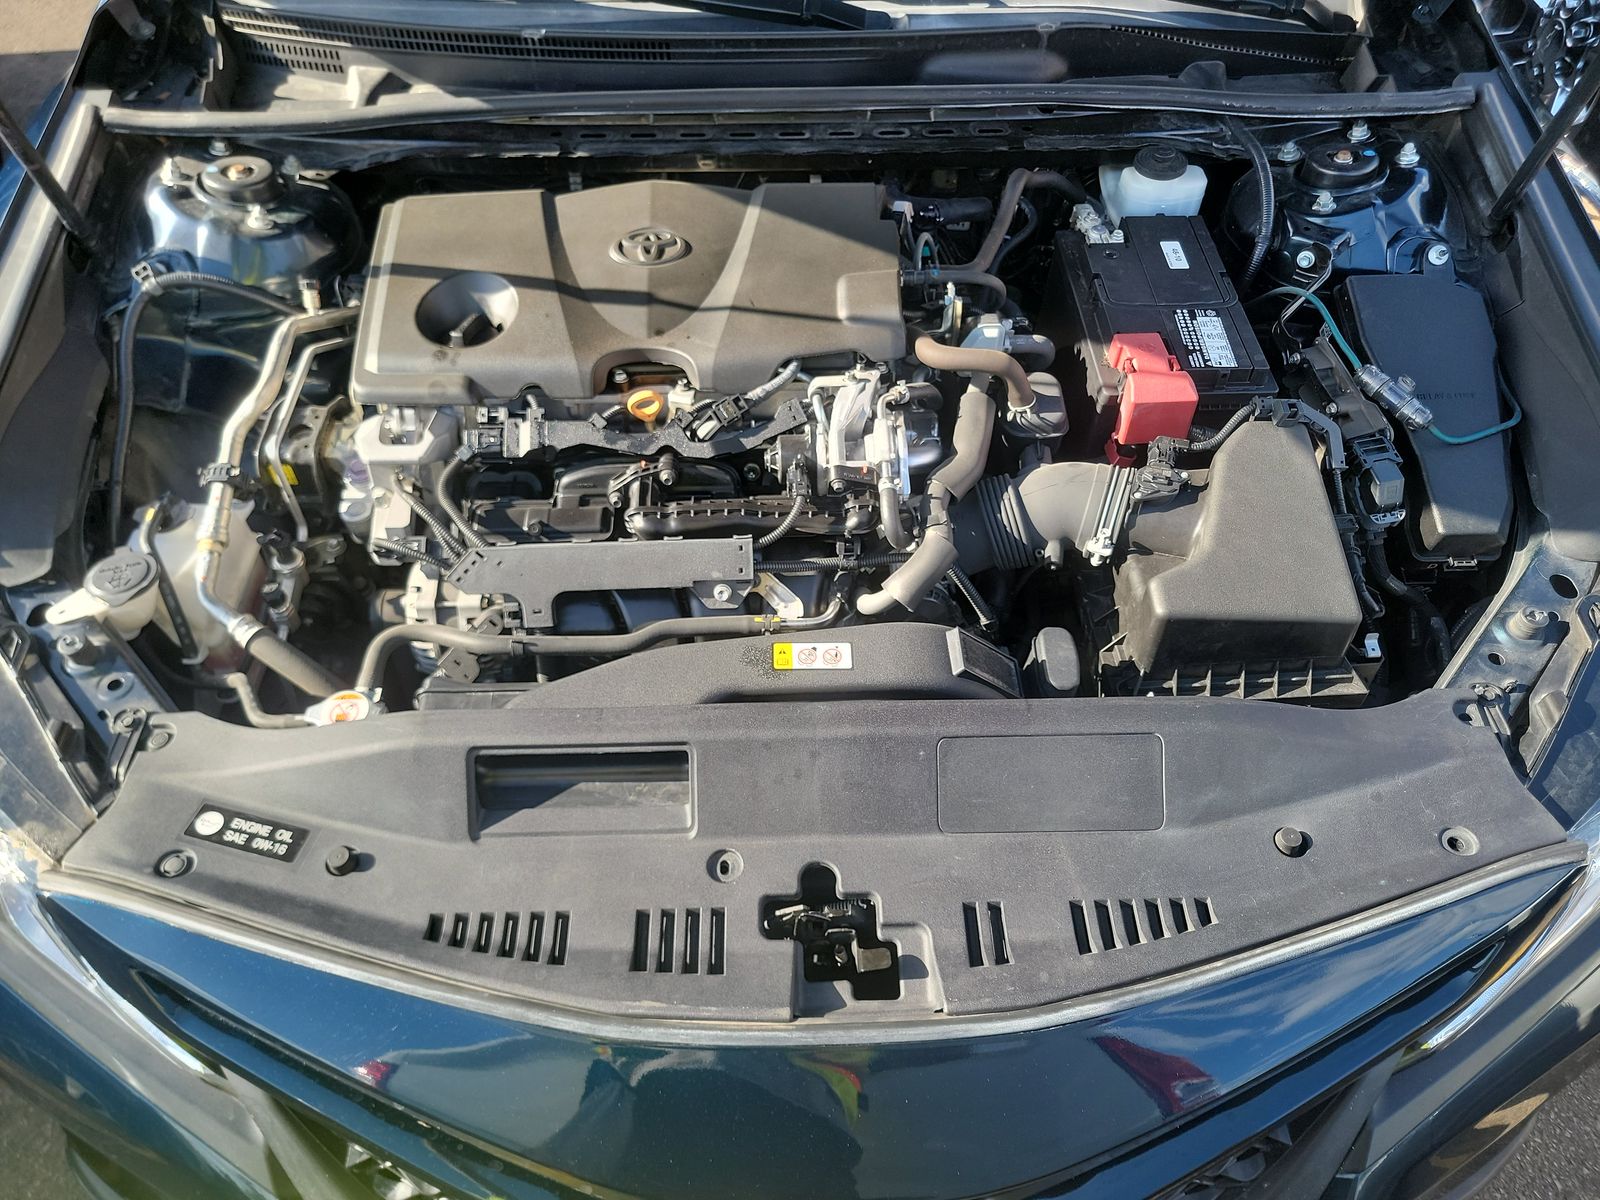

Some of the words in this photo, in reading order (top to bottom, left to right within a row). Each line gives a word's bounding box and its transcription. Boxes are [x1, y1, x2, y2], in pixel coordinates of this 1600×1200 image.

[222, 829, 249, 845] SAE
[251, 837, 288, 855] 0W-16
[230, 817, 273, 837] ENGINE
[274, 829, 293, 843] OIL
